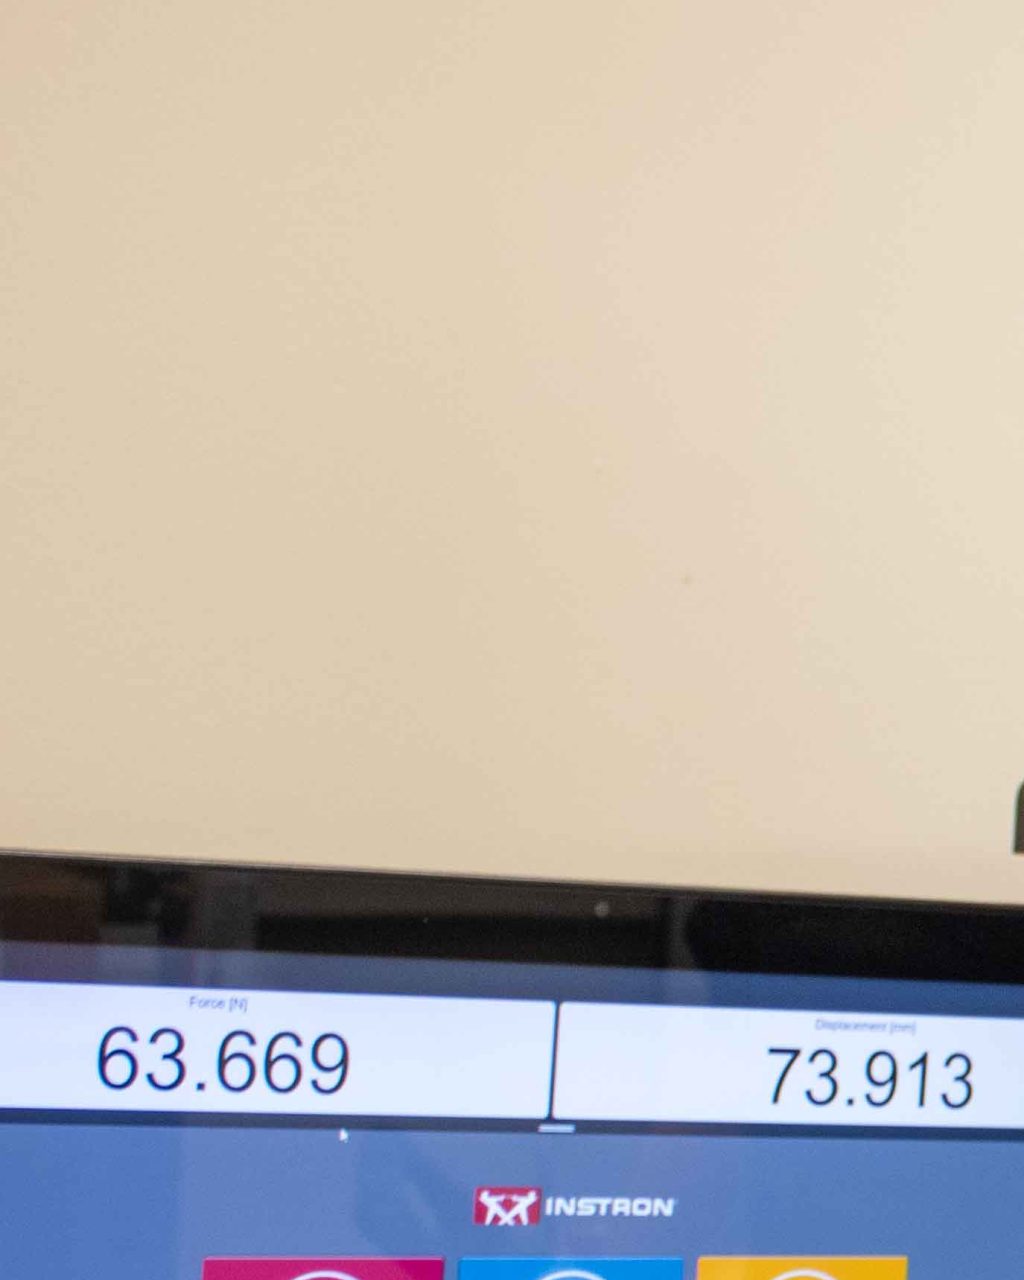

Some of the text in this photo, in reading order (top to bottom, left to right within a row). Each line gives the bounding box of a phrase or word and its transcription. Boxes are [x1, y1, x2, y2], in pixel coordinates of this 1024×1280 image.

[189, 995, 225, 1009] Force
[97, 1025, 350, 1094] 63.669
[767, 1047, 974, 1109] 73.913
[545, 1197, 675, 1216] INSTRON
